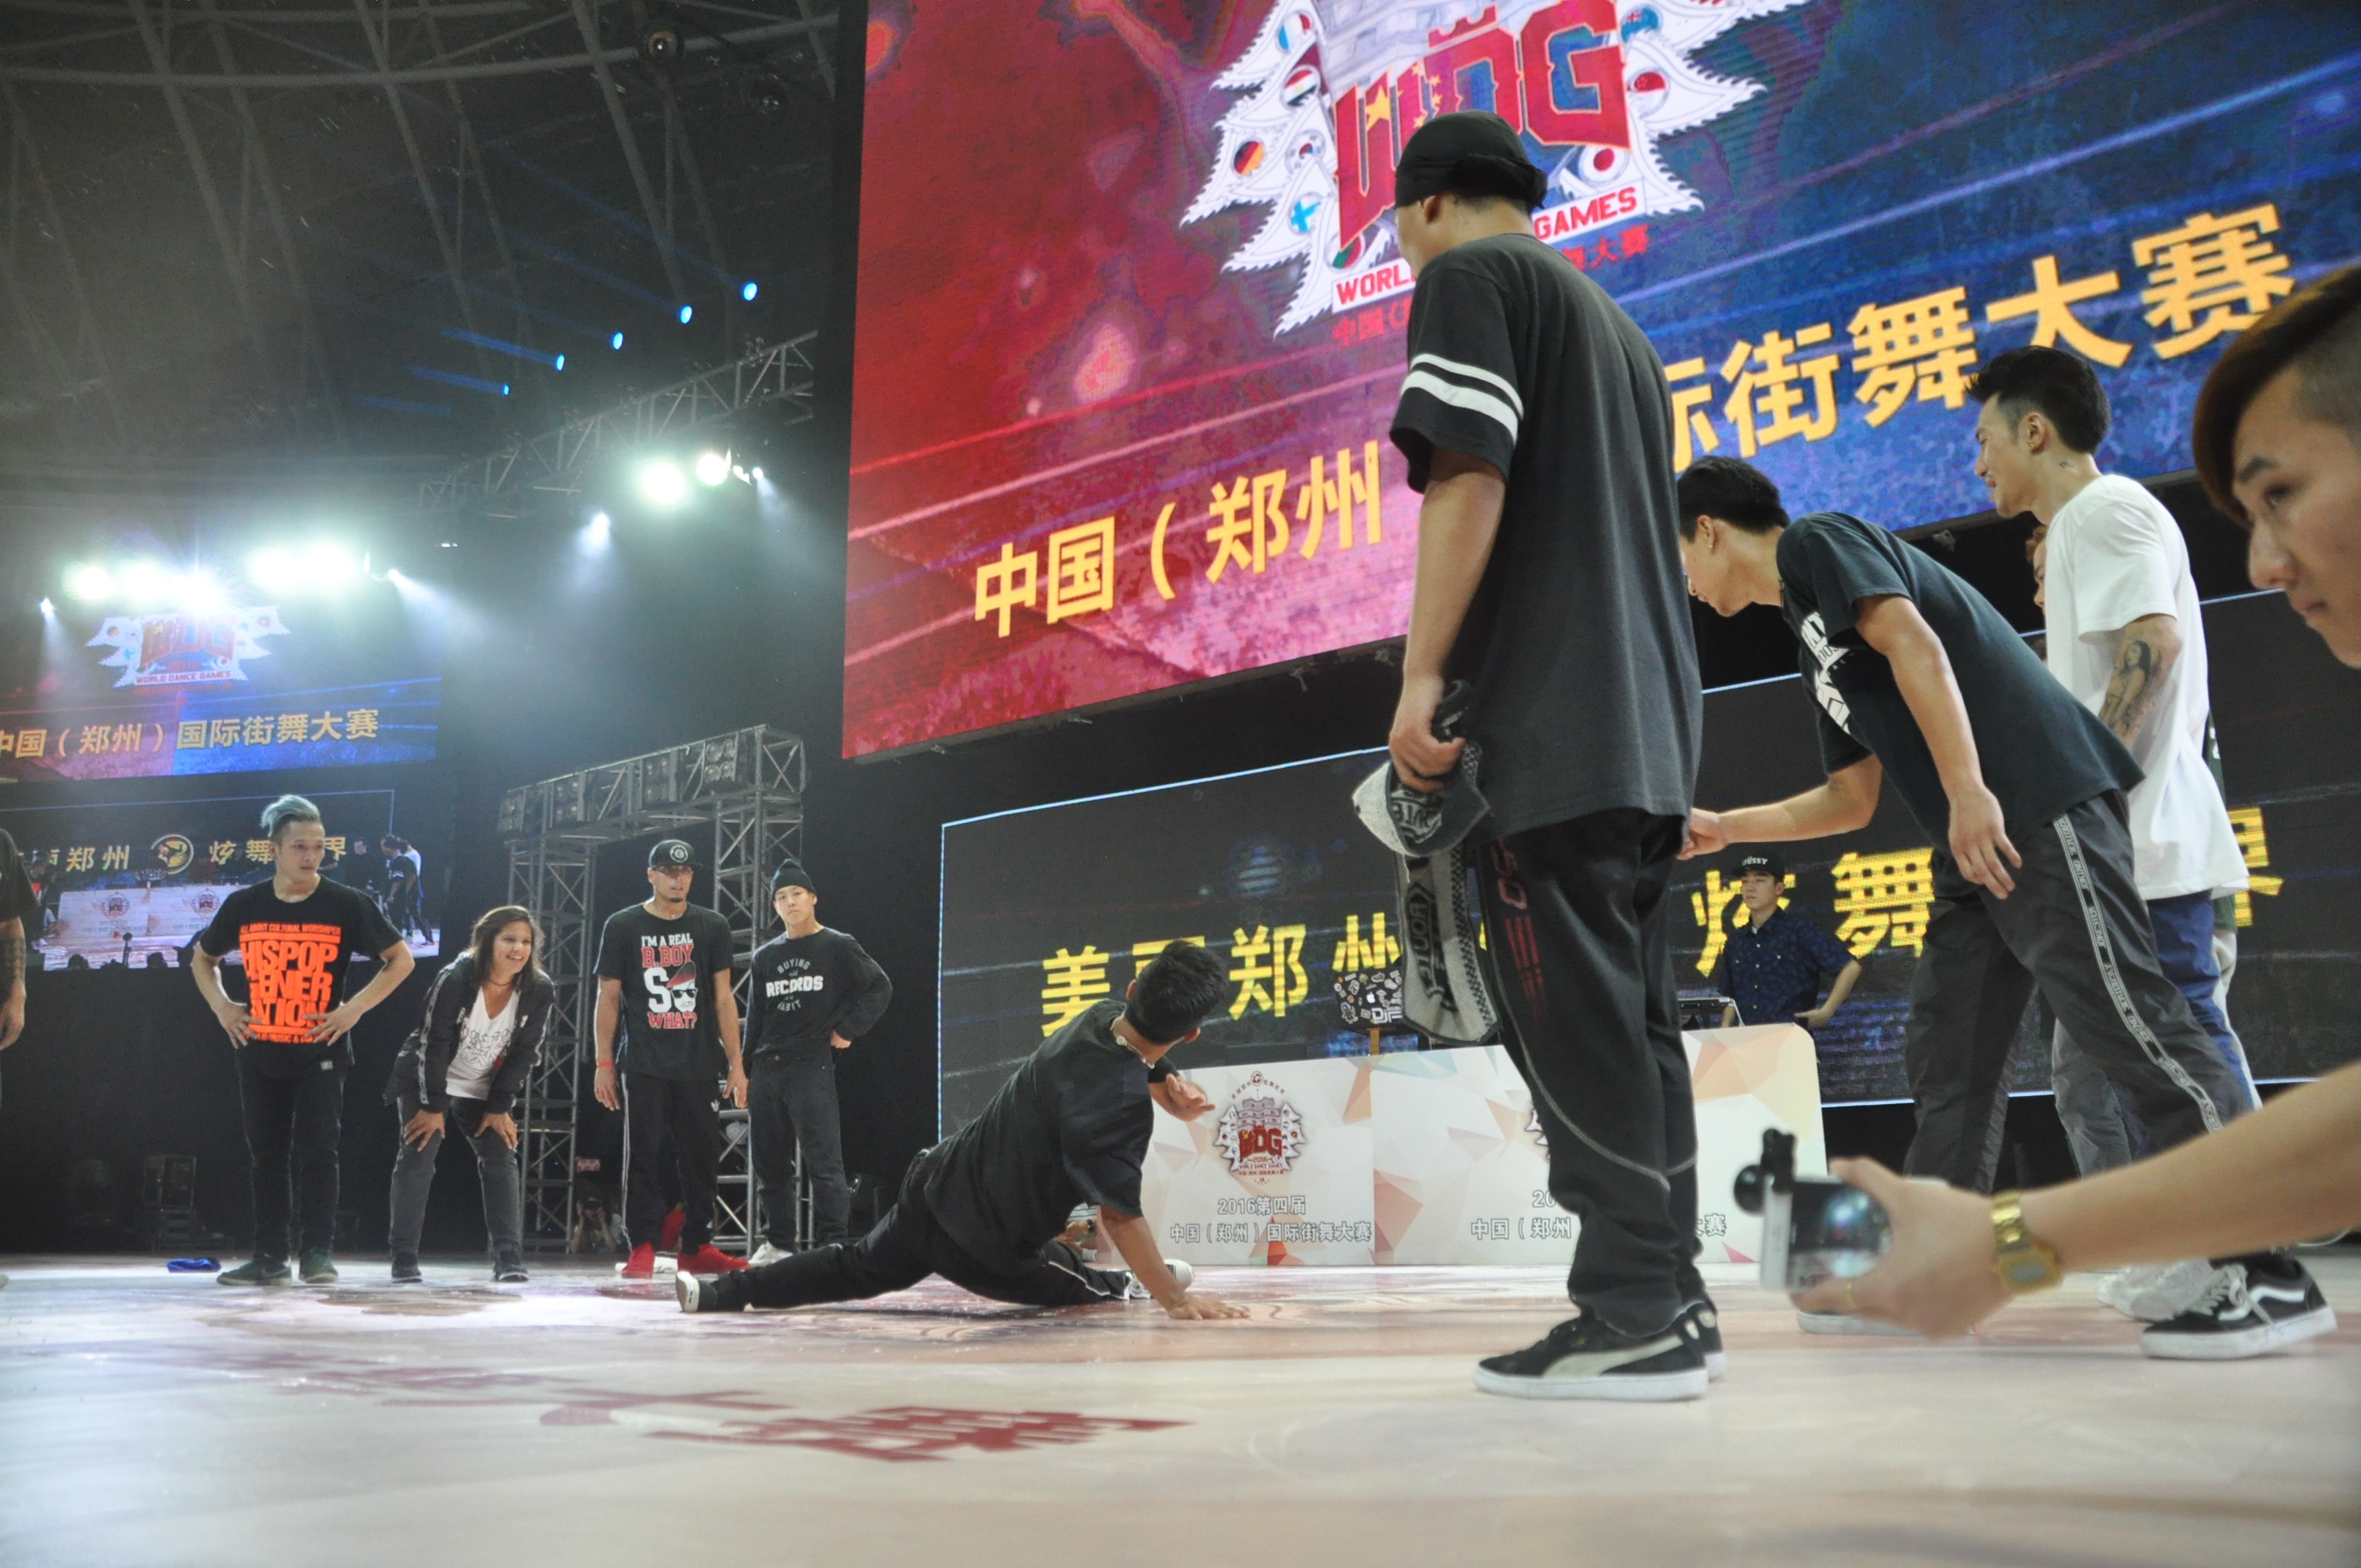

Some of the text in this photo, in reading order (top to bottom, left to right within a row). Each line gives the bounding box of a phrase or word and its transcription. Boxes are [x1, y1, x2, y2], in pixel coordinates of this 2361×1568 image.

[1336, 186, 1637, 305] WORL GAMES
[136, 669, 232, 685] WORLD DANCE GAMES
[641, 933, 694, 947] I'M A REAL
[641, 943, 694, 968] B.BOY
[777, 958, 810, 974] BUYING
[766, 975, 824, 998] RECORDS
[648, 1012, 697, 1029] WHAT?
[1217, 1195, 1307, 1216] 2016第四届
[1170, 1220, 1373, 1244] 中国（郑州）国际街舞大赛
